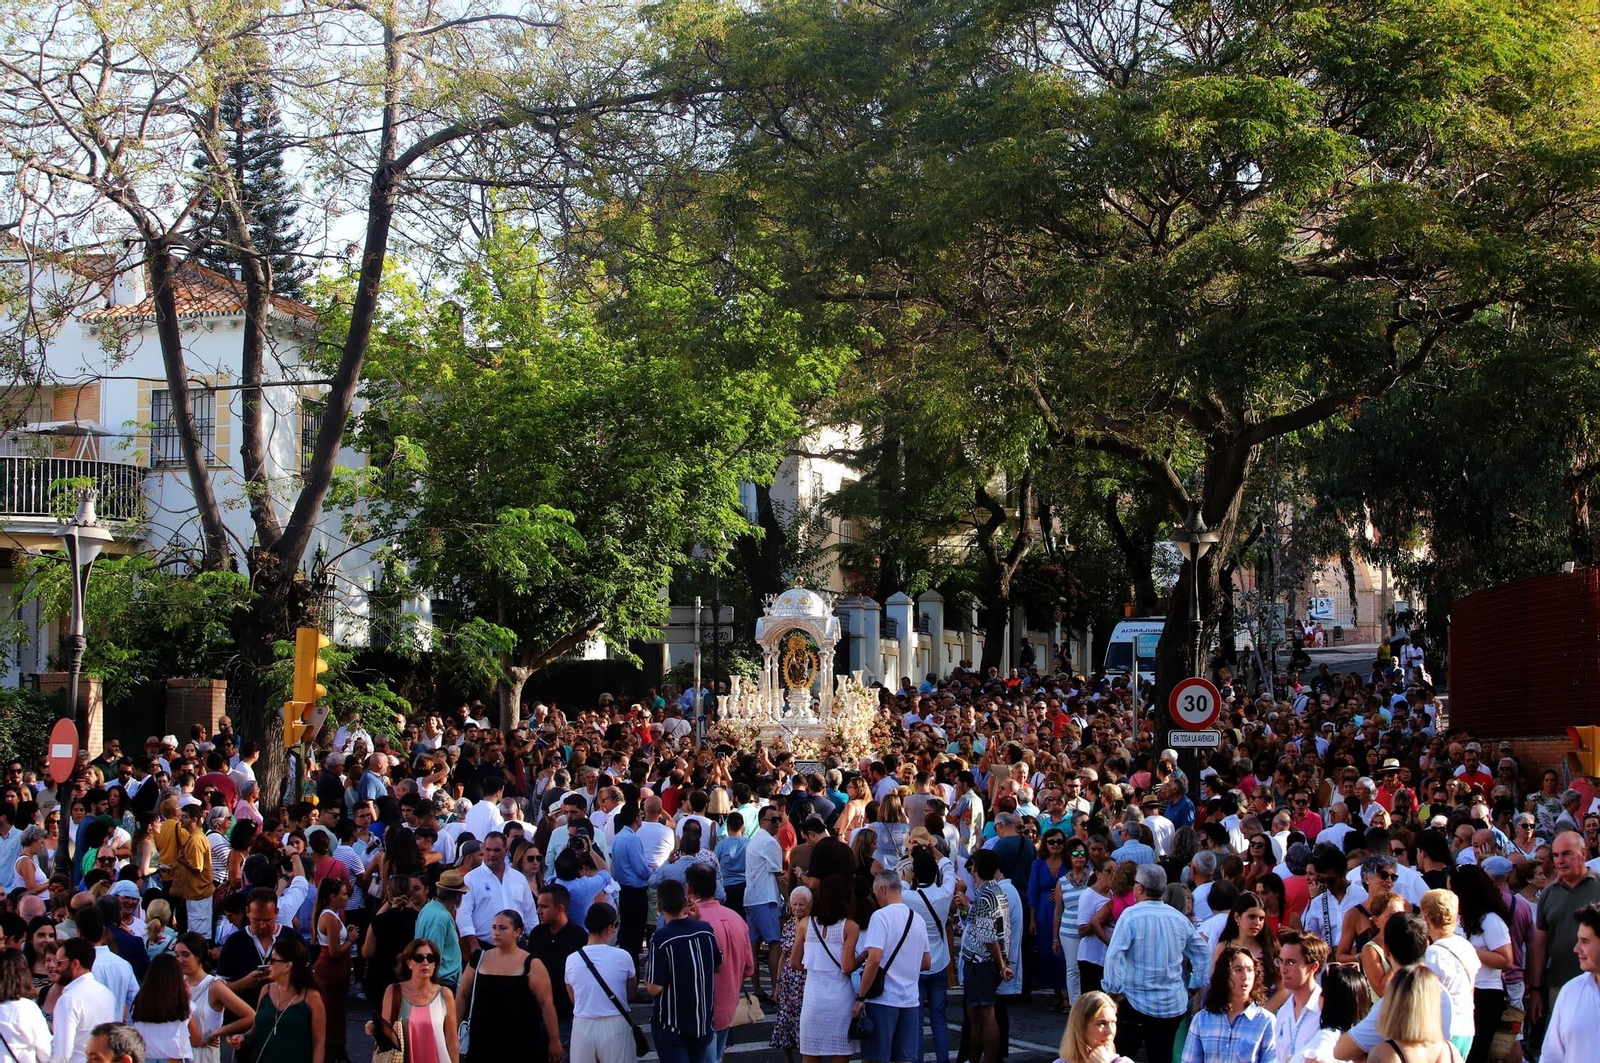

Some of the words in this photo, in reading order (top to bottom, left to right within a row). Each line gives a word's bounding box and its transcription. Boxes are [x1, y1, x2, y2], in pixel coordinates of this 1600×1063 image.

[1184, 695, 1207, 712] 30
[1173, 734, 1179, 742] EN
[1180, 734, 1191, 742] TODA
[1191, 734, 1197, 742] LA
[1198, 734, 1215, 742] AVENIDA
